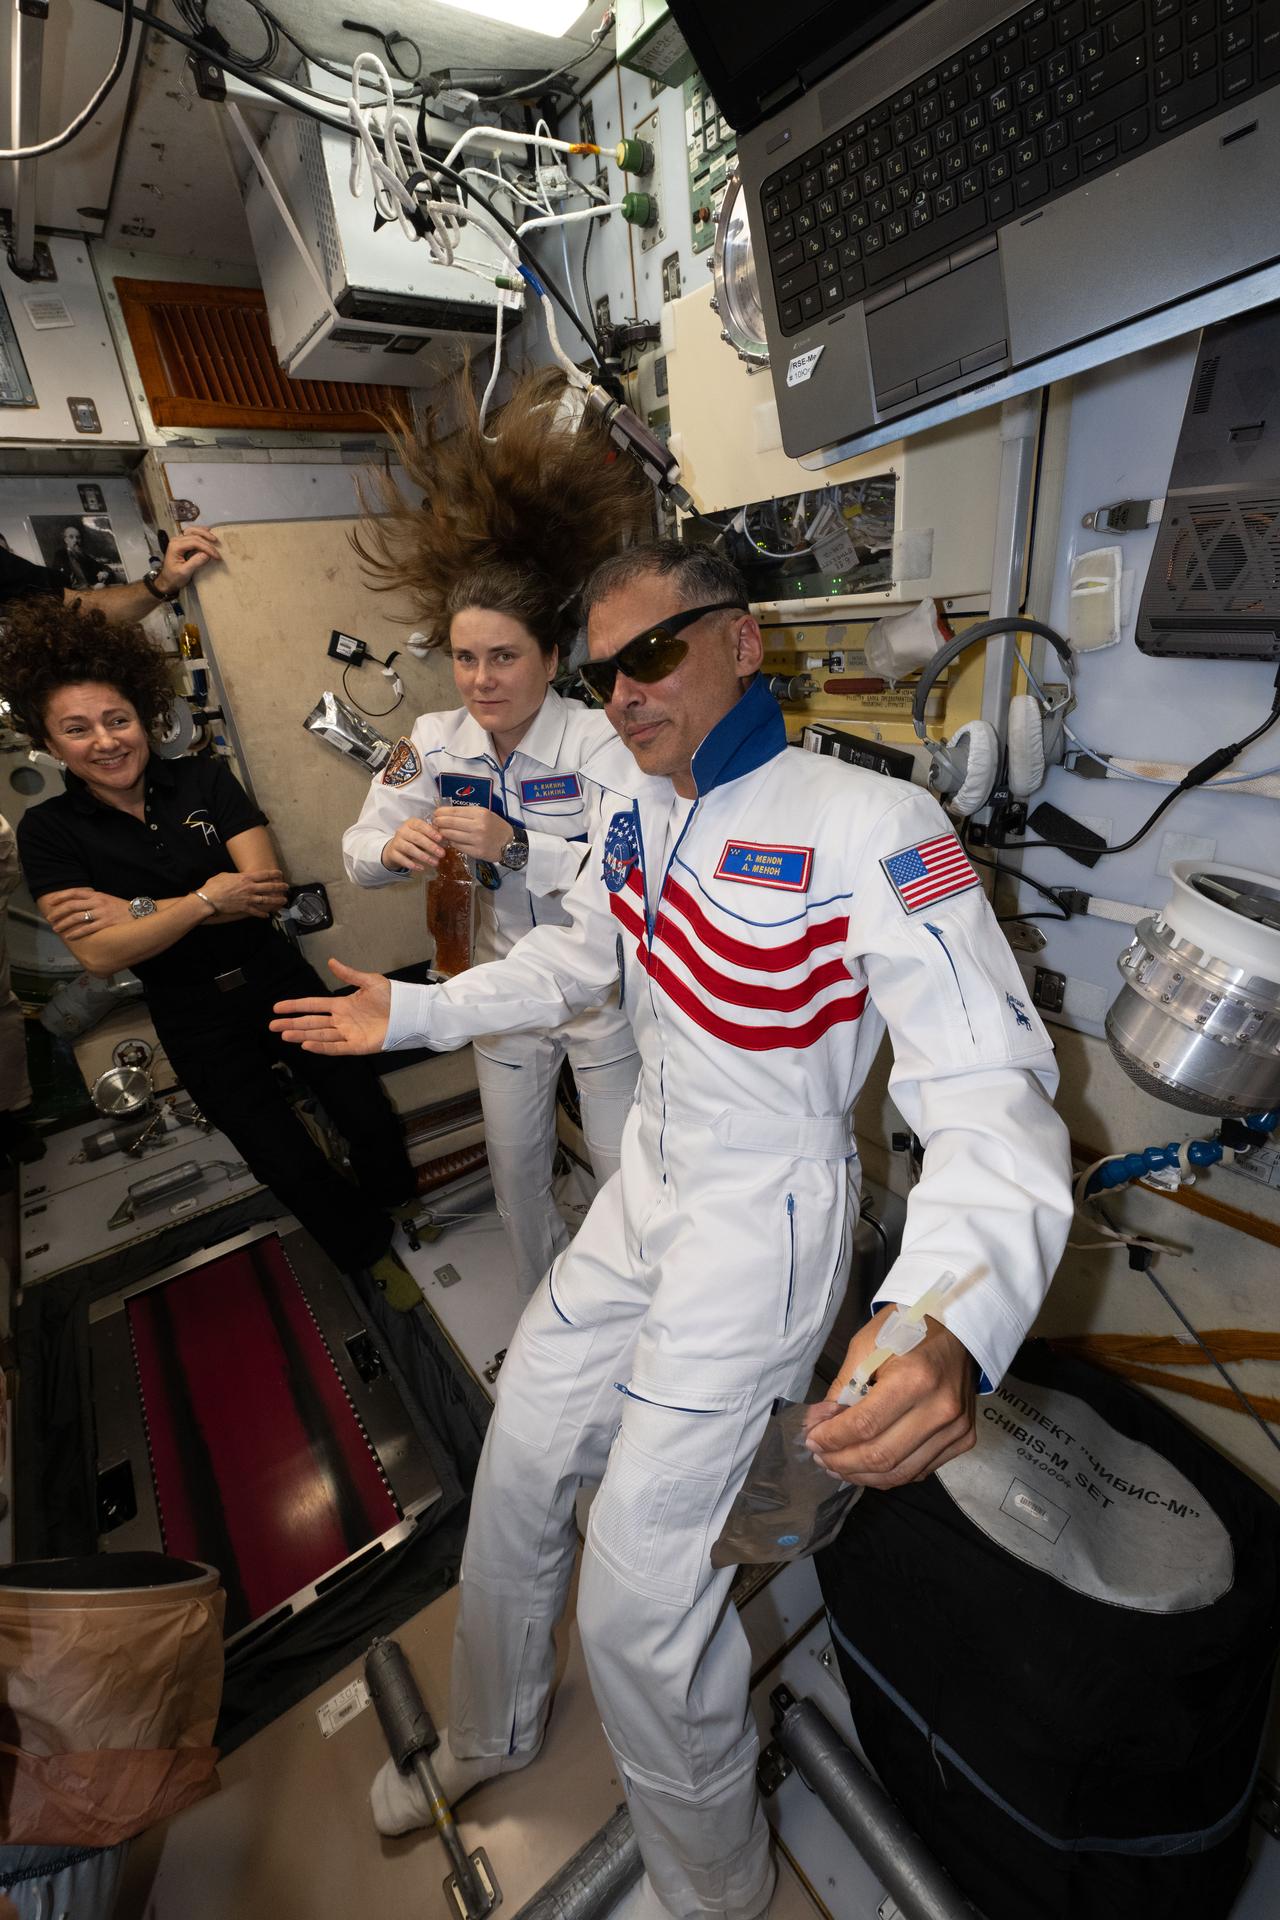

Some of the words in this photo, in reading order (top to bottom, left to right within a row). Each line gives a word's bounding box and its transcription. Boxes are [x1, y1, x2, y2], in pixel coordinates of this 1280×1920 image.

[606, 851, 627, 878] NASA
[745, 854, 753, 862] A.
[755, 856, 782, 865] MENON
[752, 865, 781, 876] МЕНОН
[983, 1407, 1069, 1471] CHIBIS-M
[1074, 1472, 1115, 1509] SET
